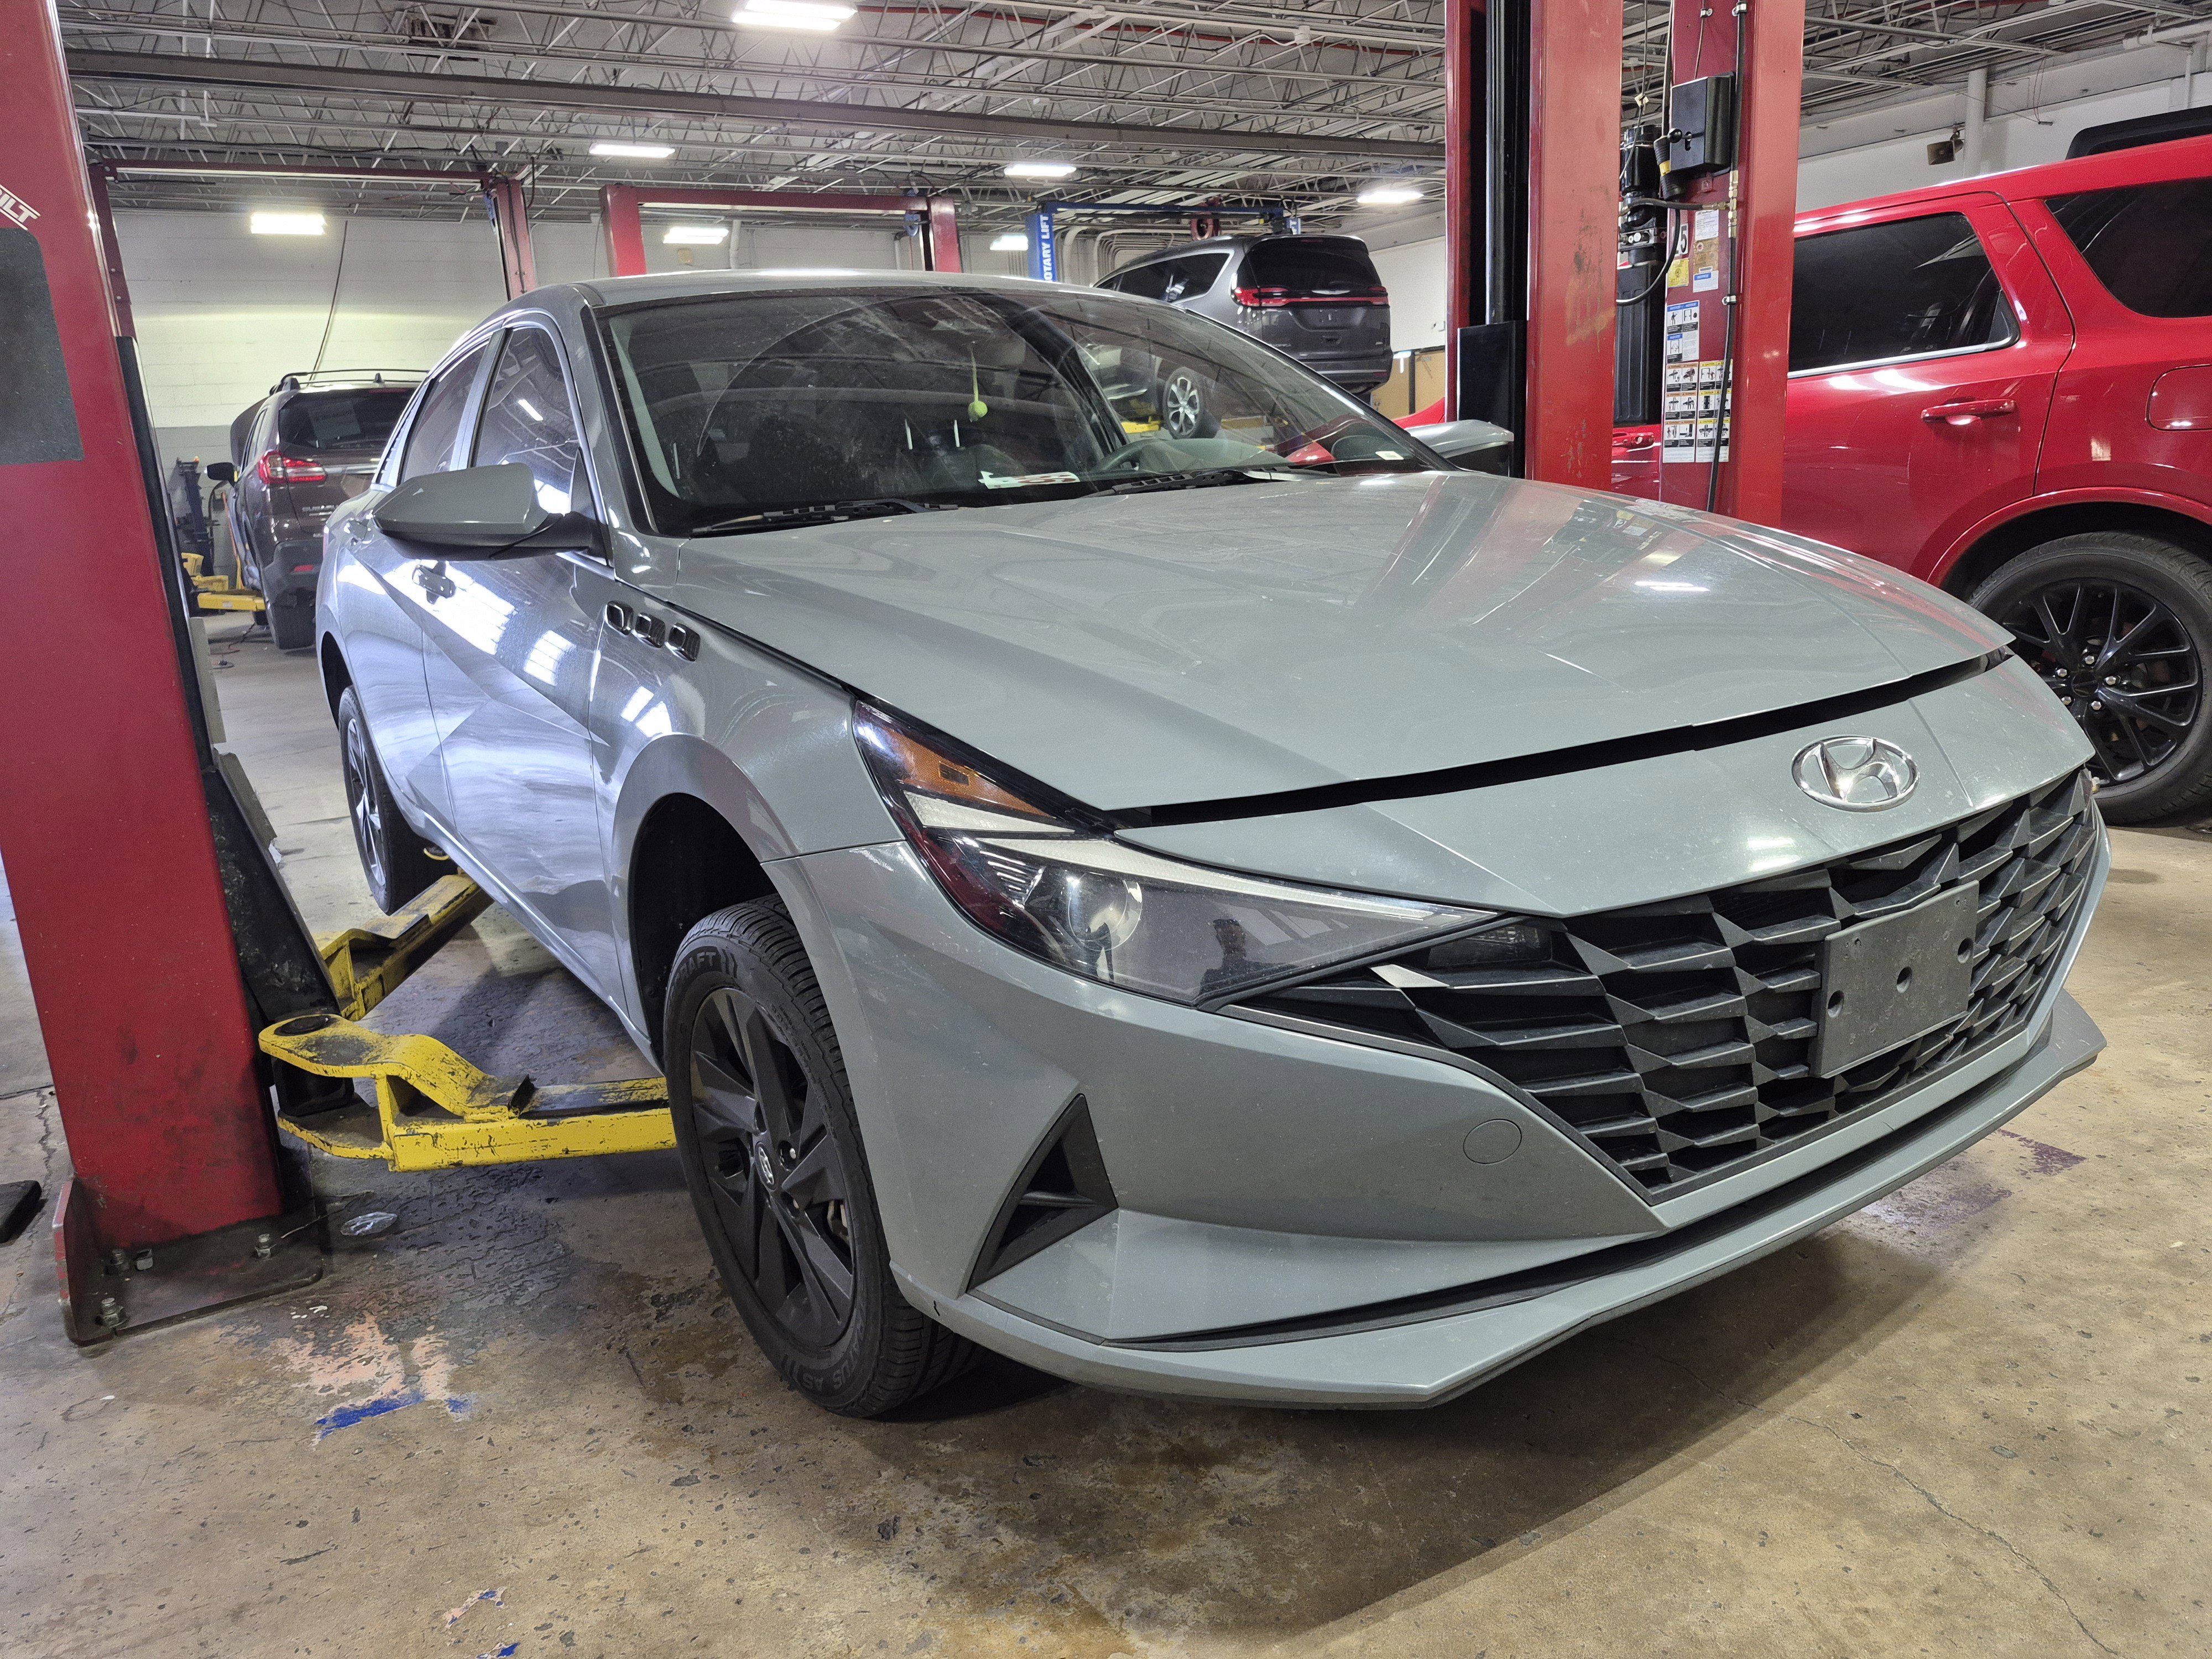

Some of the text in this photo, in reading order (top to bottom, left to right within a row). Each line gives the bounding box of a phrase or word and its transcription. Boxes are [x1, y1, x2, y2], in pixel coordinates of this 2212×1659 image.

[0, 189, 38, 223] ILT
[1040, 214, 1053, 281] OTARY LIFT
